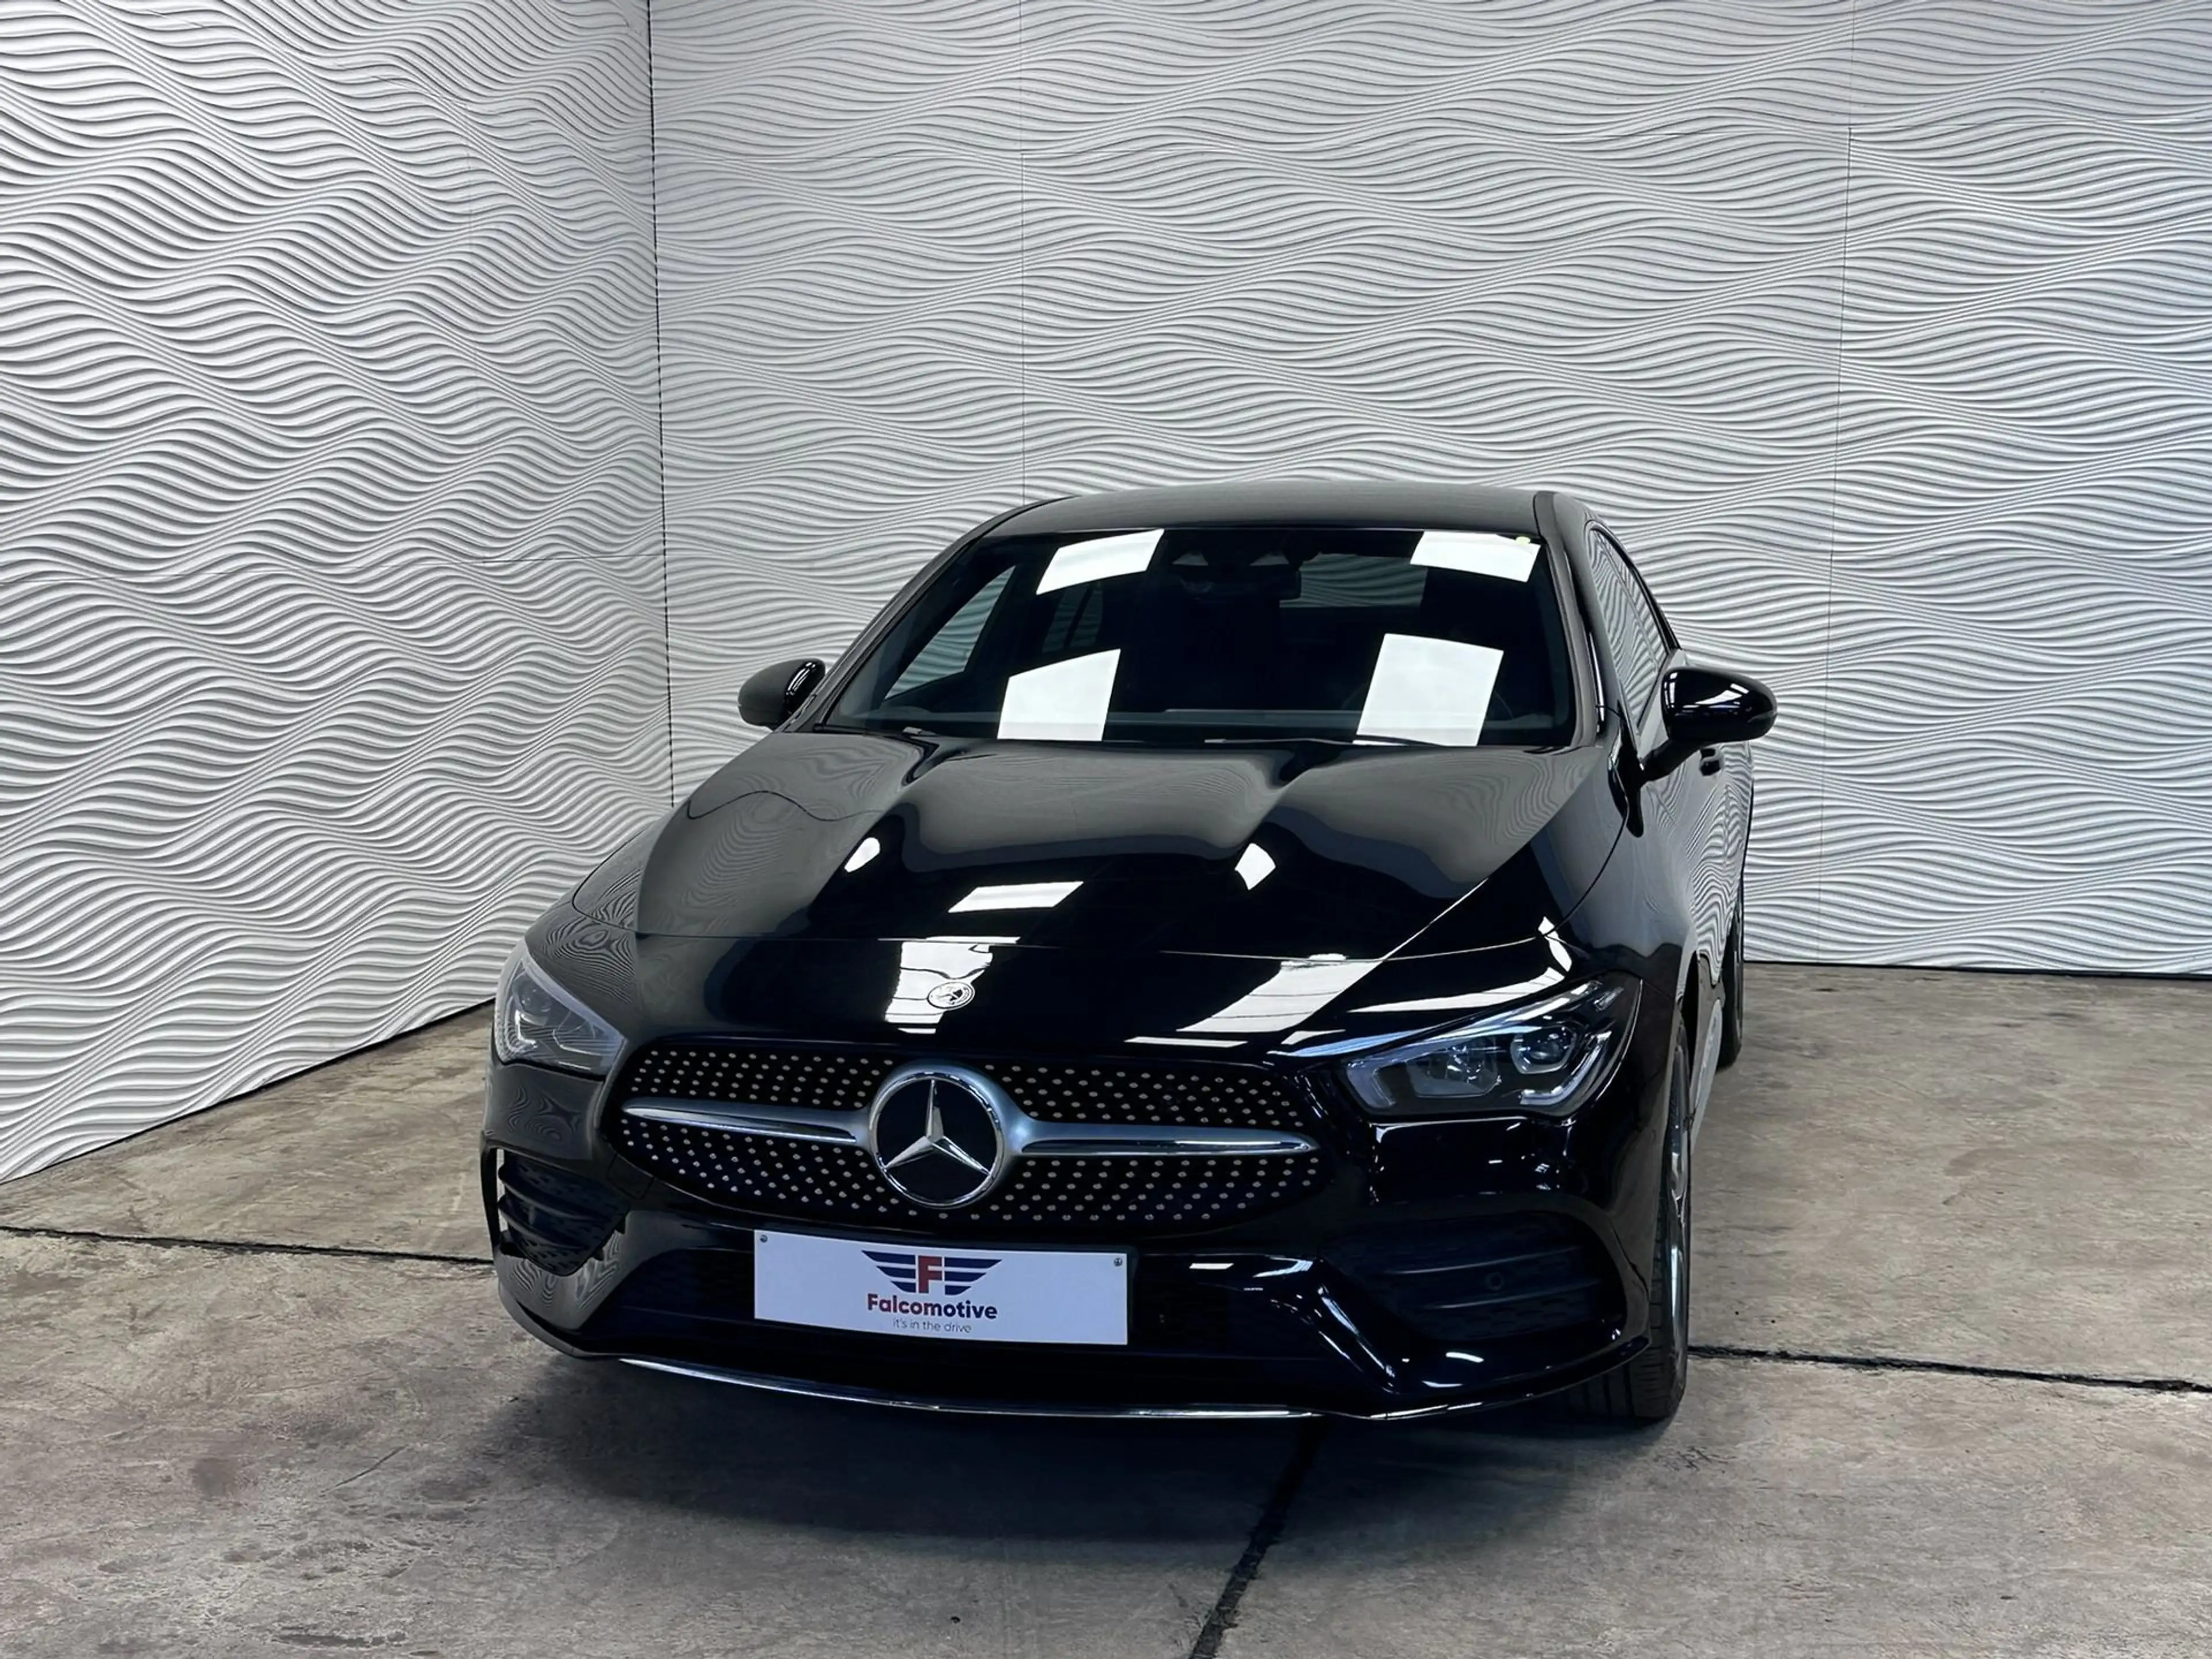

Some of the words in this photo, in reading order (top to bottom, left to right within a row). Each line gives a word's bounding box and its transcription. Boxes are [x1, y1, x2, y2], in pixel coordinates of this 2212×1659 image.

[918, 1255, 942, 1294] F
[867, 1293, 998, 1319] Falcomotive
[893, 1317, 907, 1328] it's
[910, 1319, 919, 1330] in
[923, 1320, 941, 1331] the
[944, 1321, 972, 1334] drive
